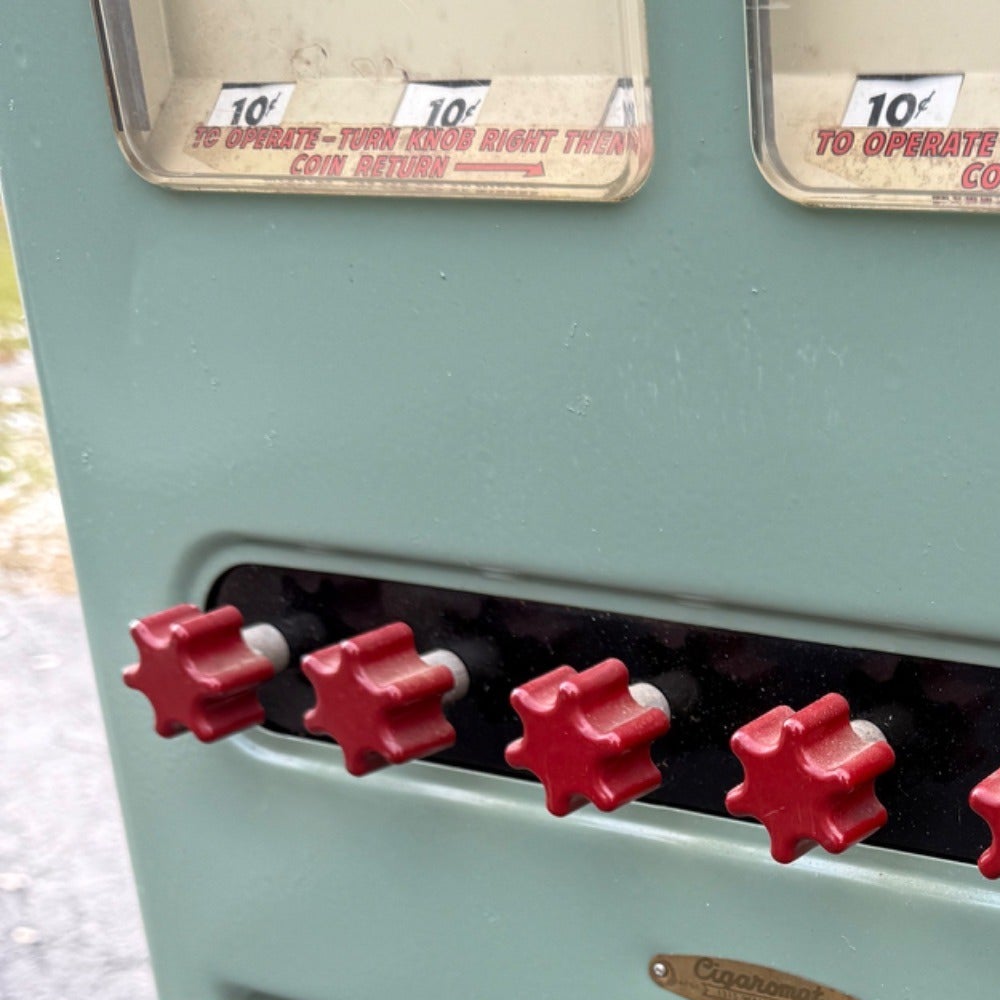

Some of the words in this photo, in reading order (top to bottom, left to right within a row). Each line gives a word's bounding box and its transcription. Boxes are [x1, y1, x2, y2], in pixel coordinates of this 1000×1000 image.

[230, 91, 282, 126] 10¢
[426, 98, 481, 127] 10¢
[866, 90, 936, 128] 10¢
[405, 127, 476, 151] KNOB
[479, 128, 558, 154] RIGHT
[562, 130, 627, 156] THEN
[815, 129, 855, 156] TO
[290, 154, 348, 177] COIN
[355, 155, 450, 178] RETURN
